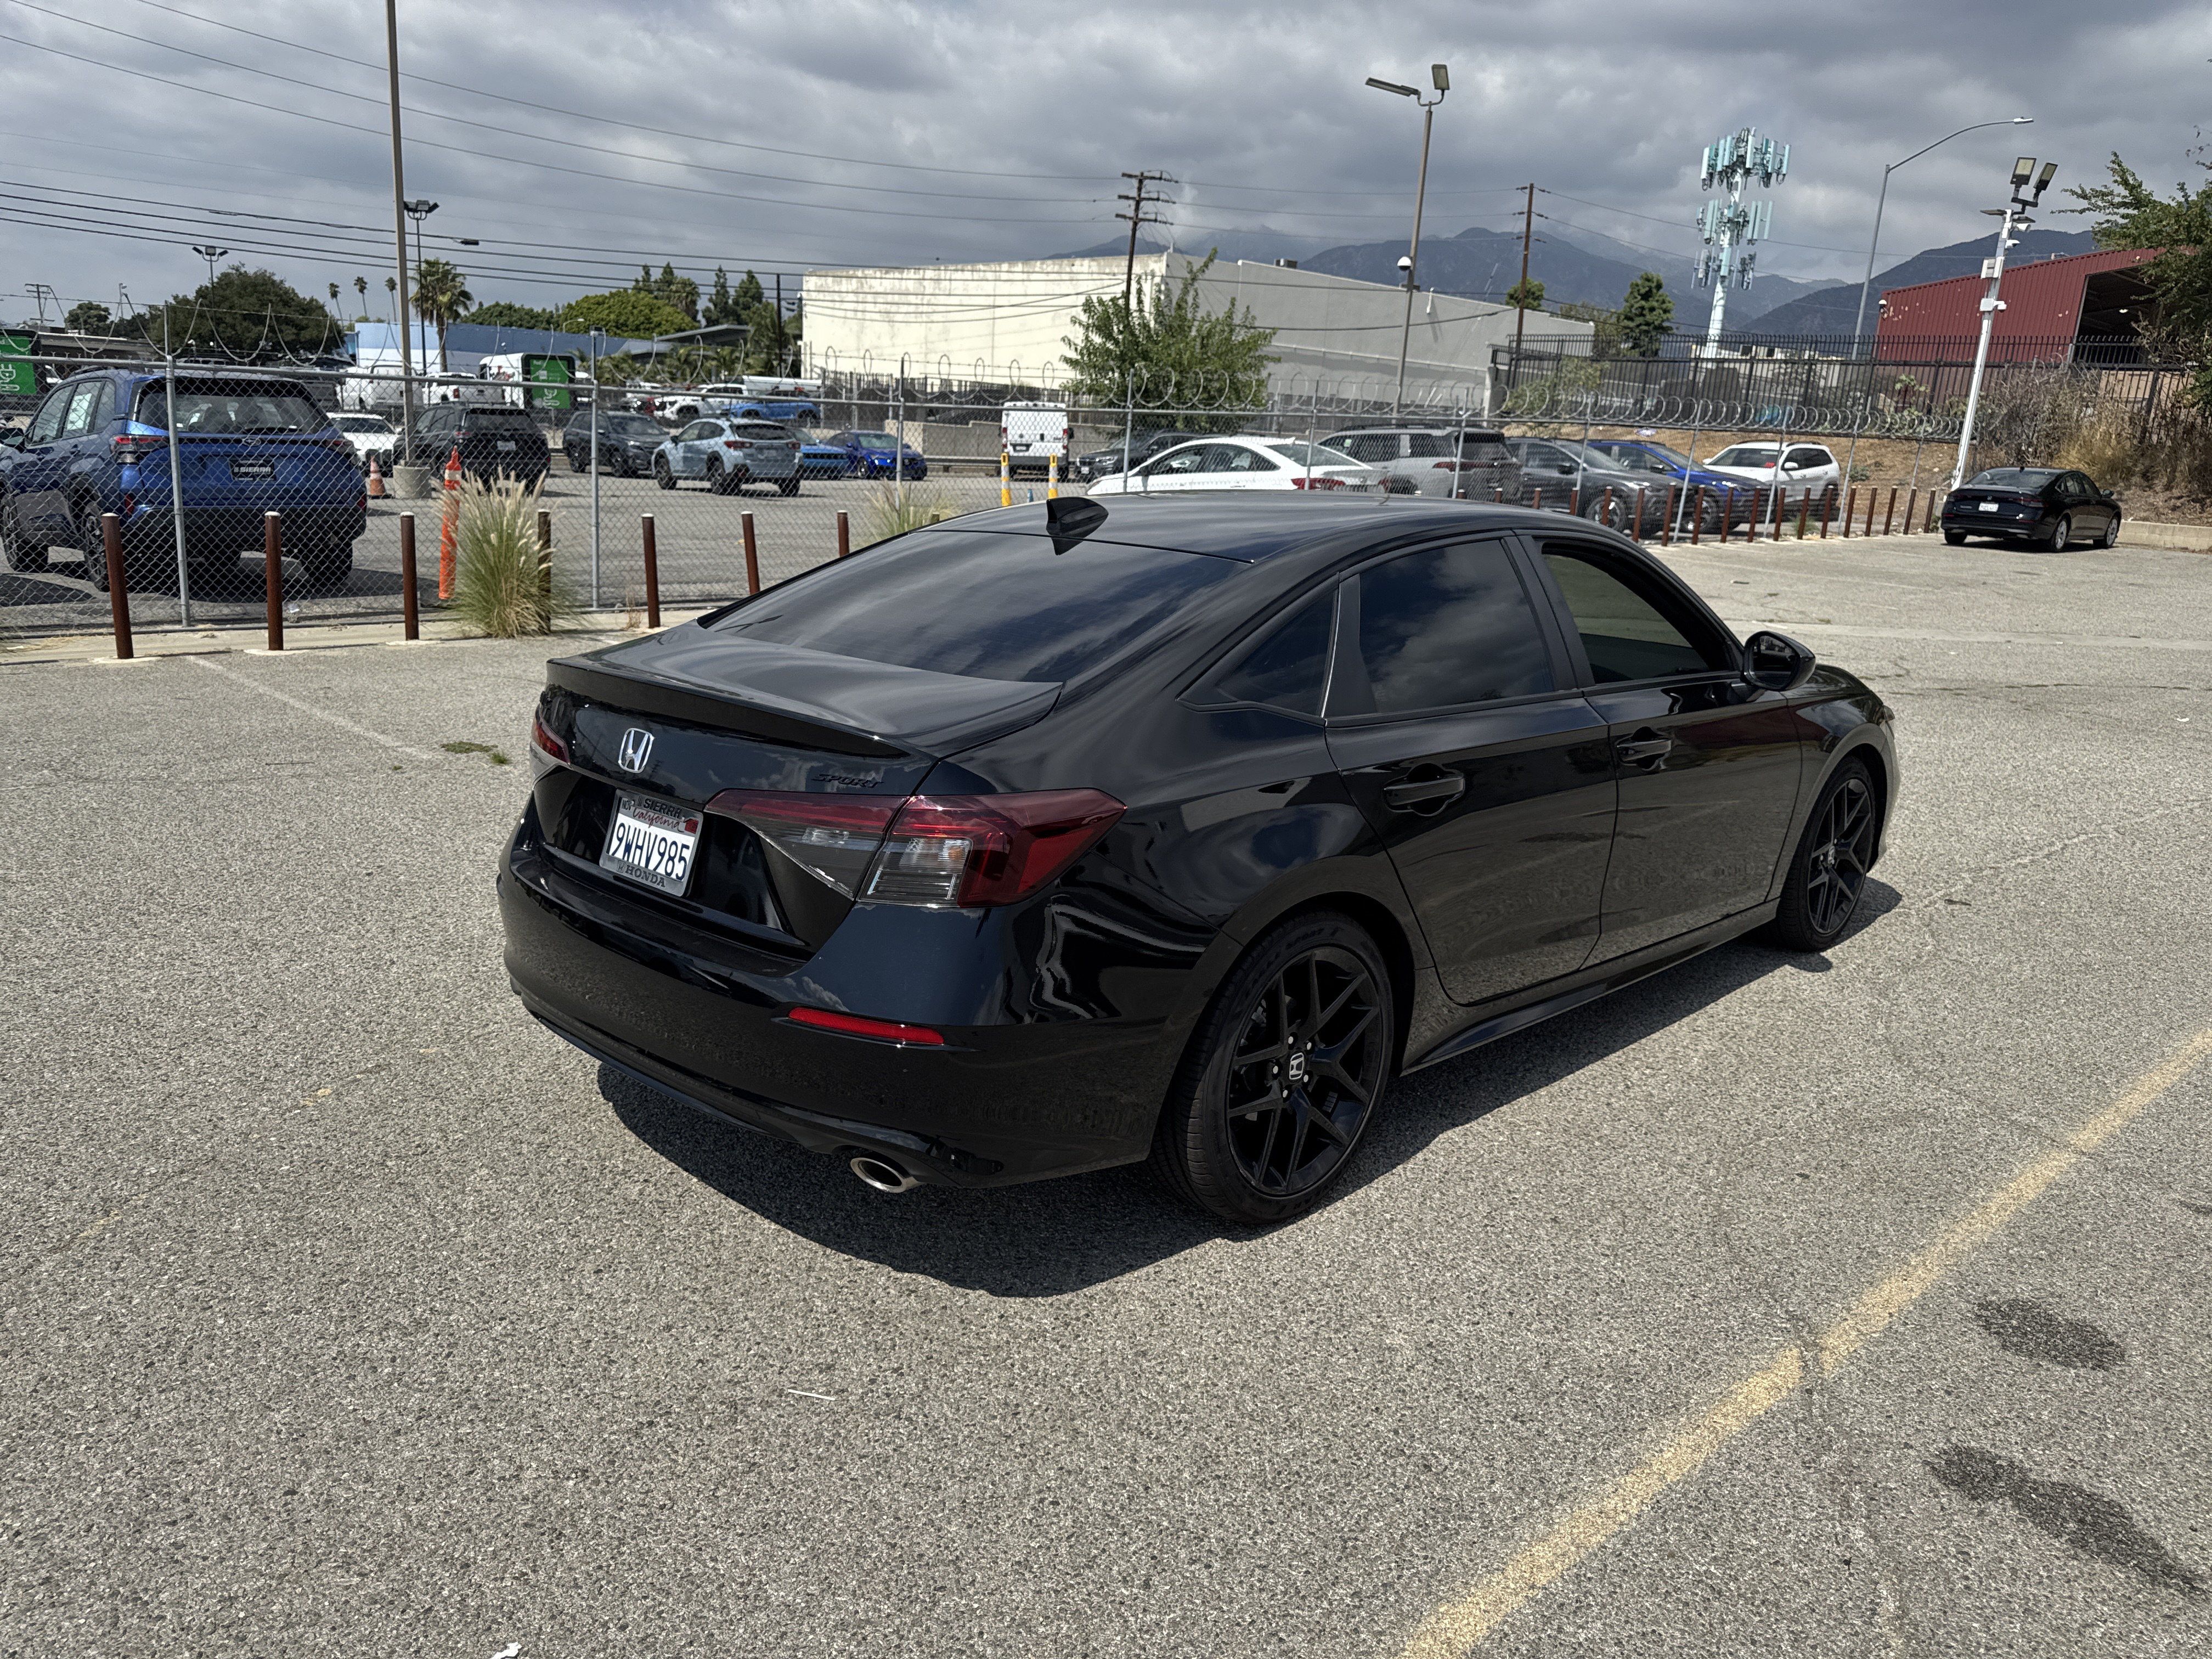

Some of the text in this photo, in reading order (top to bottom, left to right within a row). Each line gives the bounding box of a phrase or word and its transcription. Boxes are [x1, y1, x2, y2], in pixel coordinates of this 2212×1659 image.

[811, 774, 885, 788] SPORT
[643, 798, 682, 819] SIERRA
[611, 822, 690, 881] 9WHV985
[625, 865, 666, 888] HONDA
